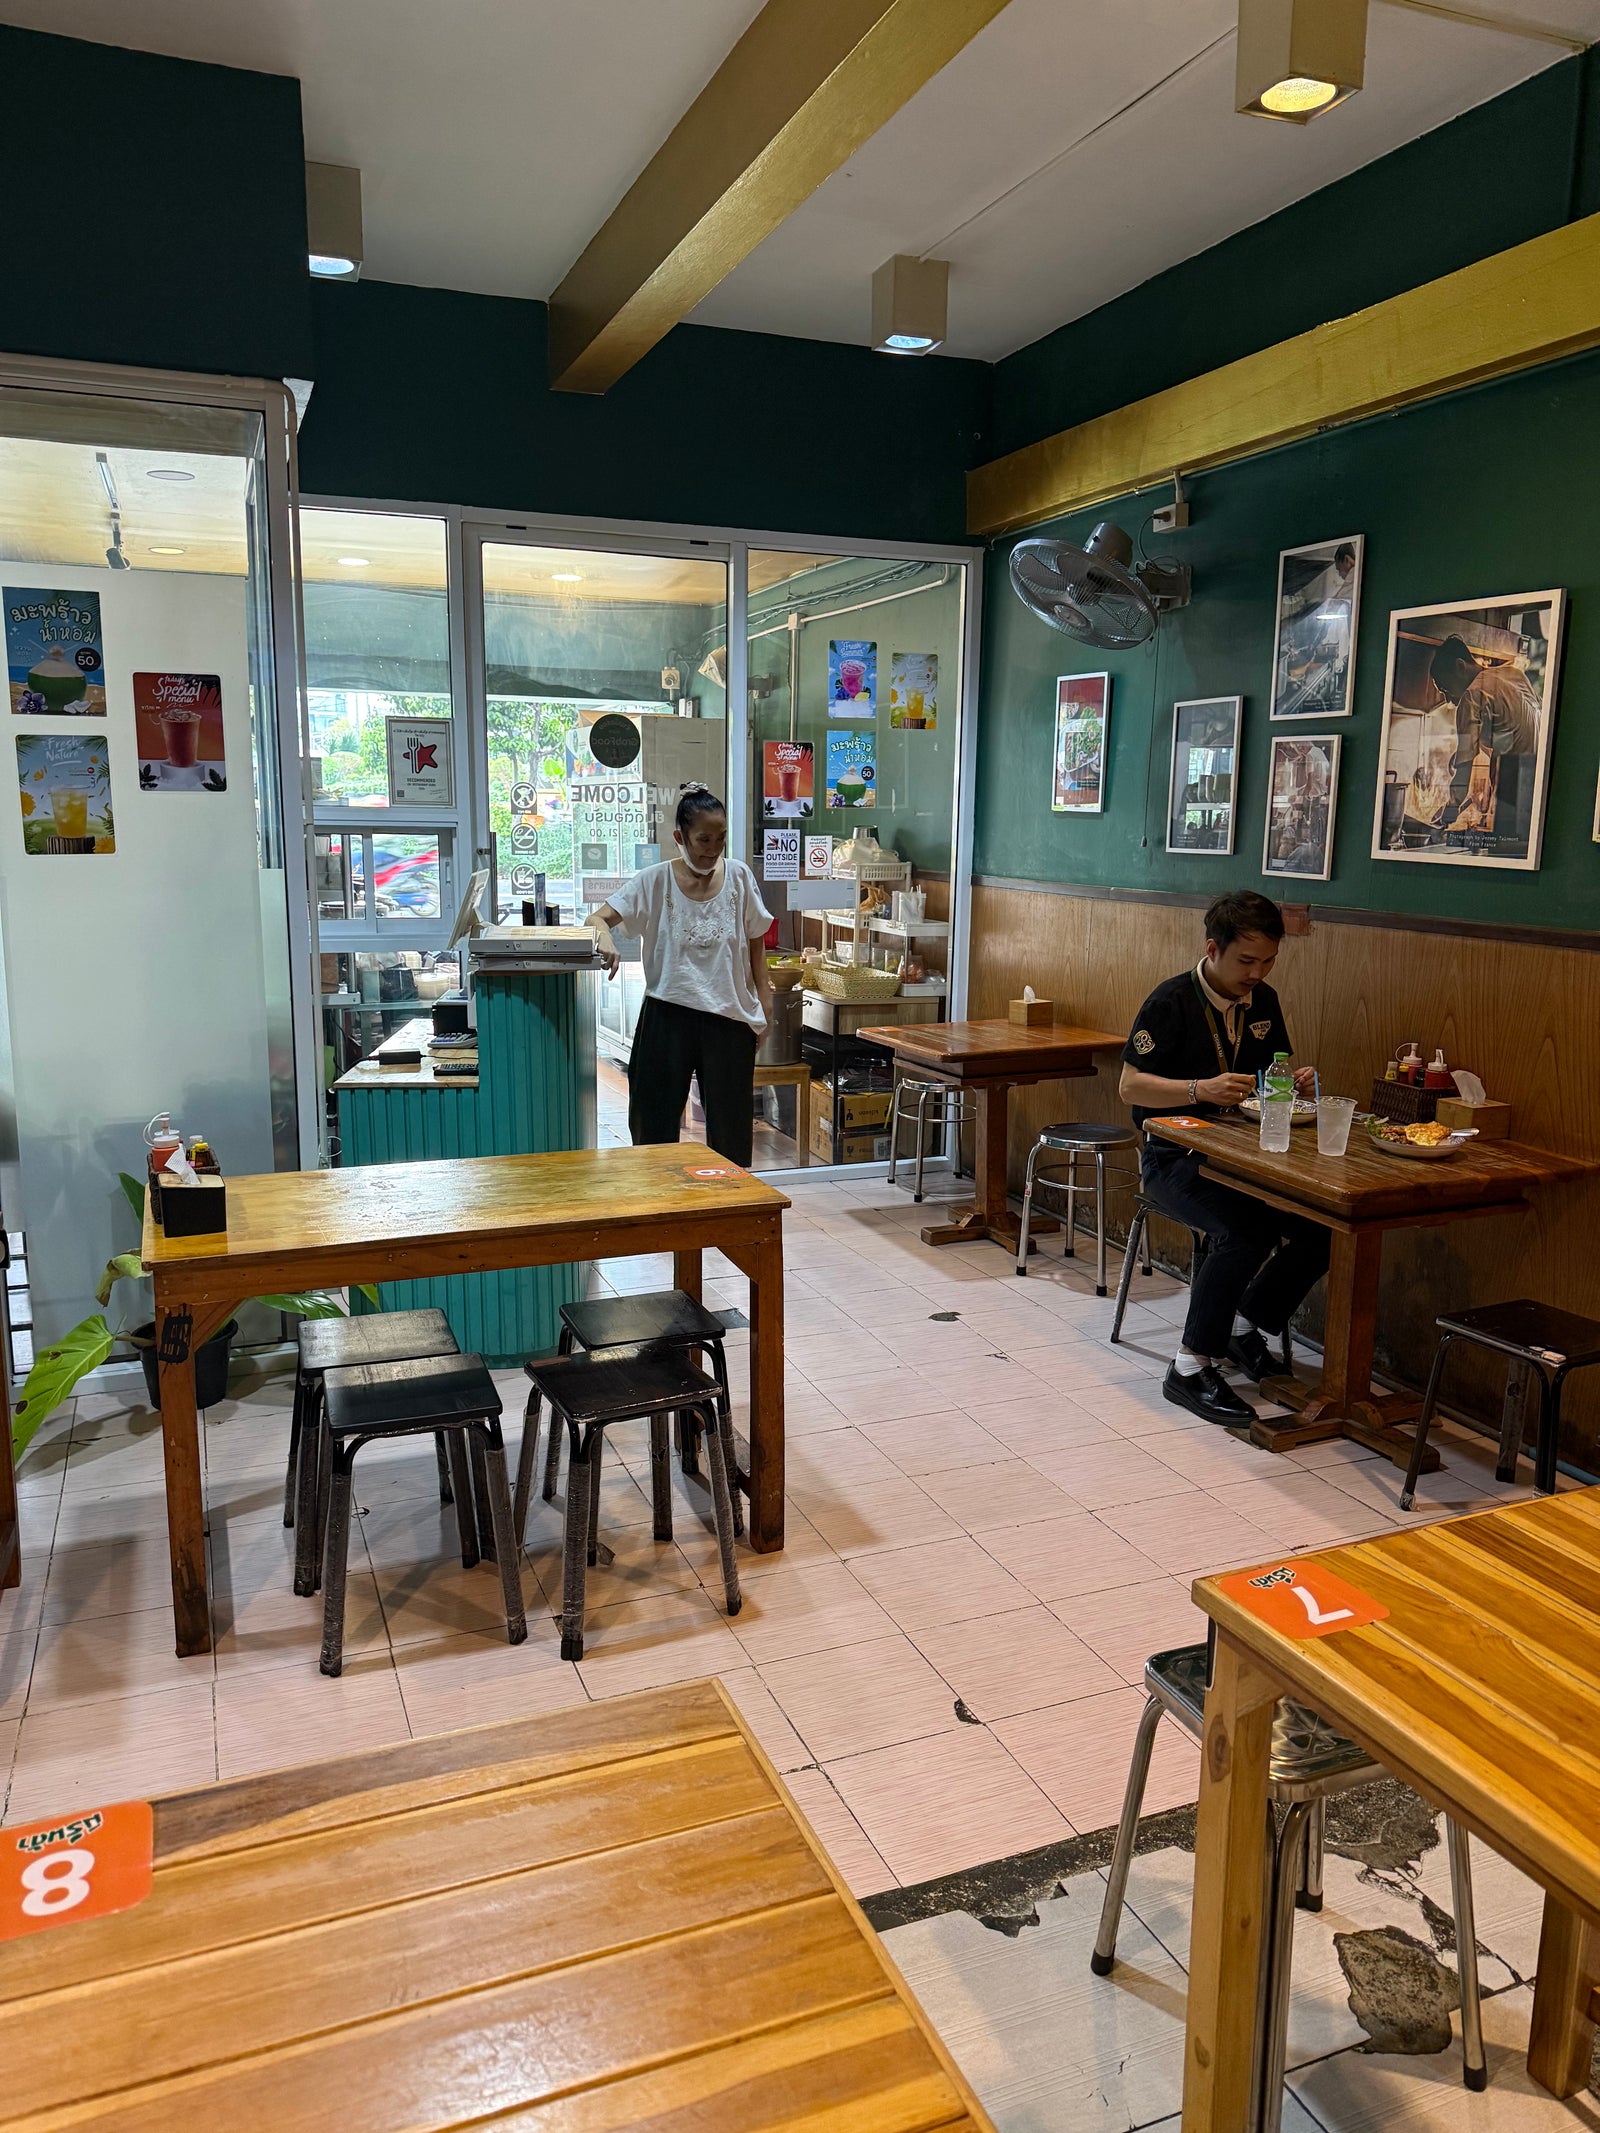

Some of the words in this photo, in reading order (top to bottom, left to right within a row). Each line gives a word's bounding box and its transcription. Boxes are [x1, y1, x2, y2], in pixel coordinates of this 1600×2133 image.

[11, 598, 92, 625] มะพร้าว
[40, 619, 96, 644] น้ำหอม
[77, 656, 95, 666] 50
[152, 678, 202, 701] Special
[168, 695, 195, 703] menu
[46, 736, 80, 750] Fresh
[830, 736, 872, 752] มะพร้าว
[45, 749, 79, 761] Nature
[774, 743, 803, 760] Special
[844, 750, 874, 763] น้ำหอม
[862, 770, 872, 778] 50
[780, 839, 798, 852] NO
[766, 853, 798, 861] OUTSIDE
[1290, 1586, 1355, 1626] 7
[21, 1849, 95, 1917] 8
